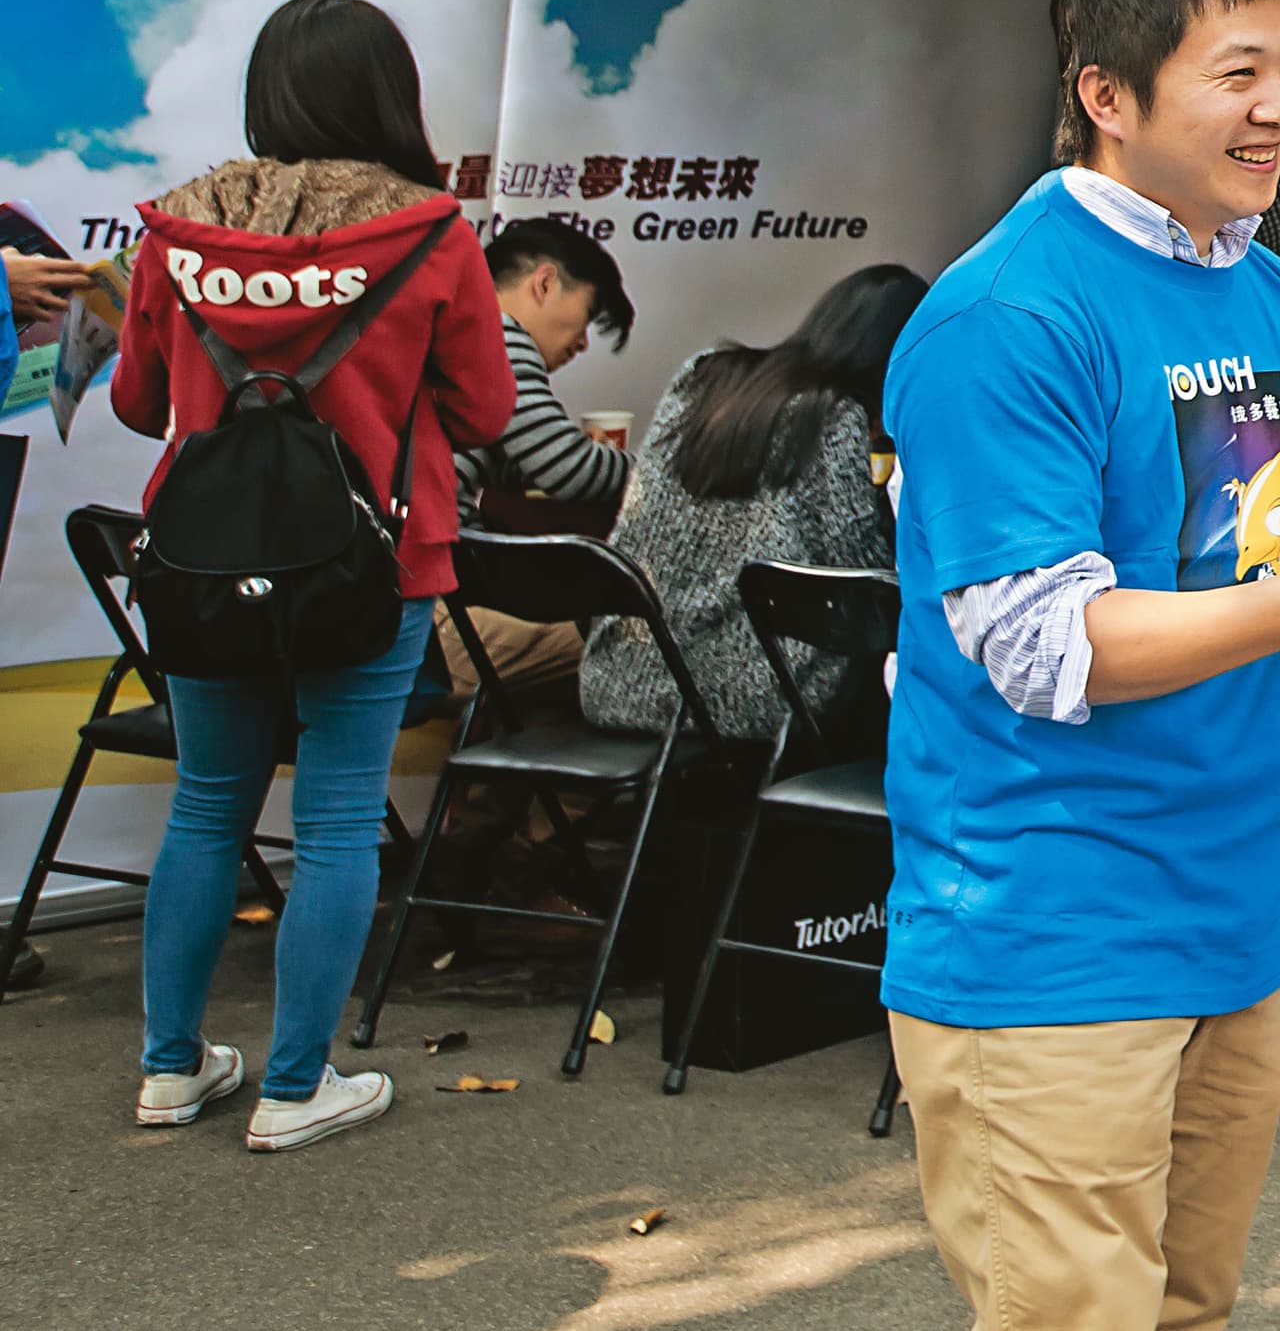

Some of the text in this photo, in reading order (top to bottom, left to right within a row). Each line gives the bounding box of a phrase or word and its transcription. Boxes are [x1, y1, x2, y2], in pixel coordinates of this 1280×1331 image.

[441, 154, 760, 201] 量迎接夢想未來
[632, 212, 738, 241] Green
[750, 210, 868, 239] Future
[166, 247, 368, 311] Roots
